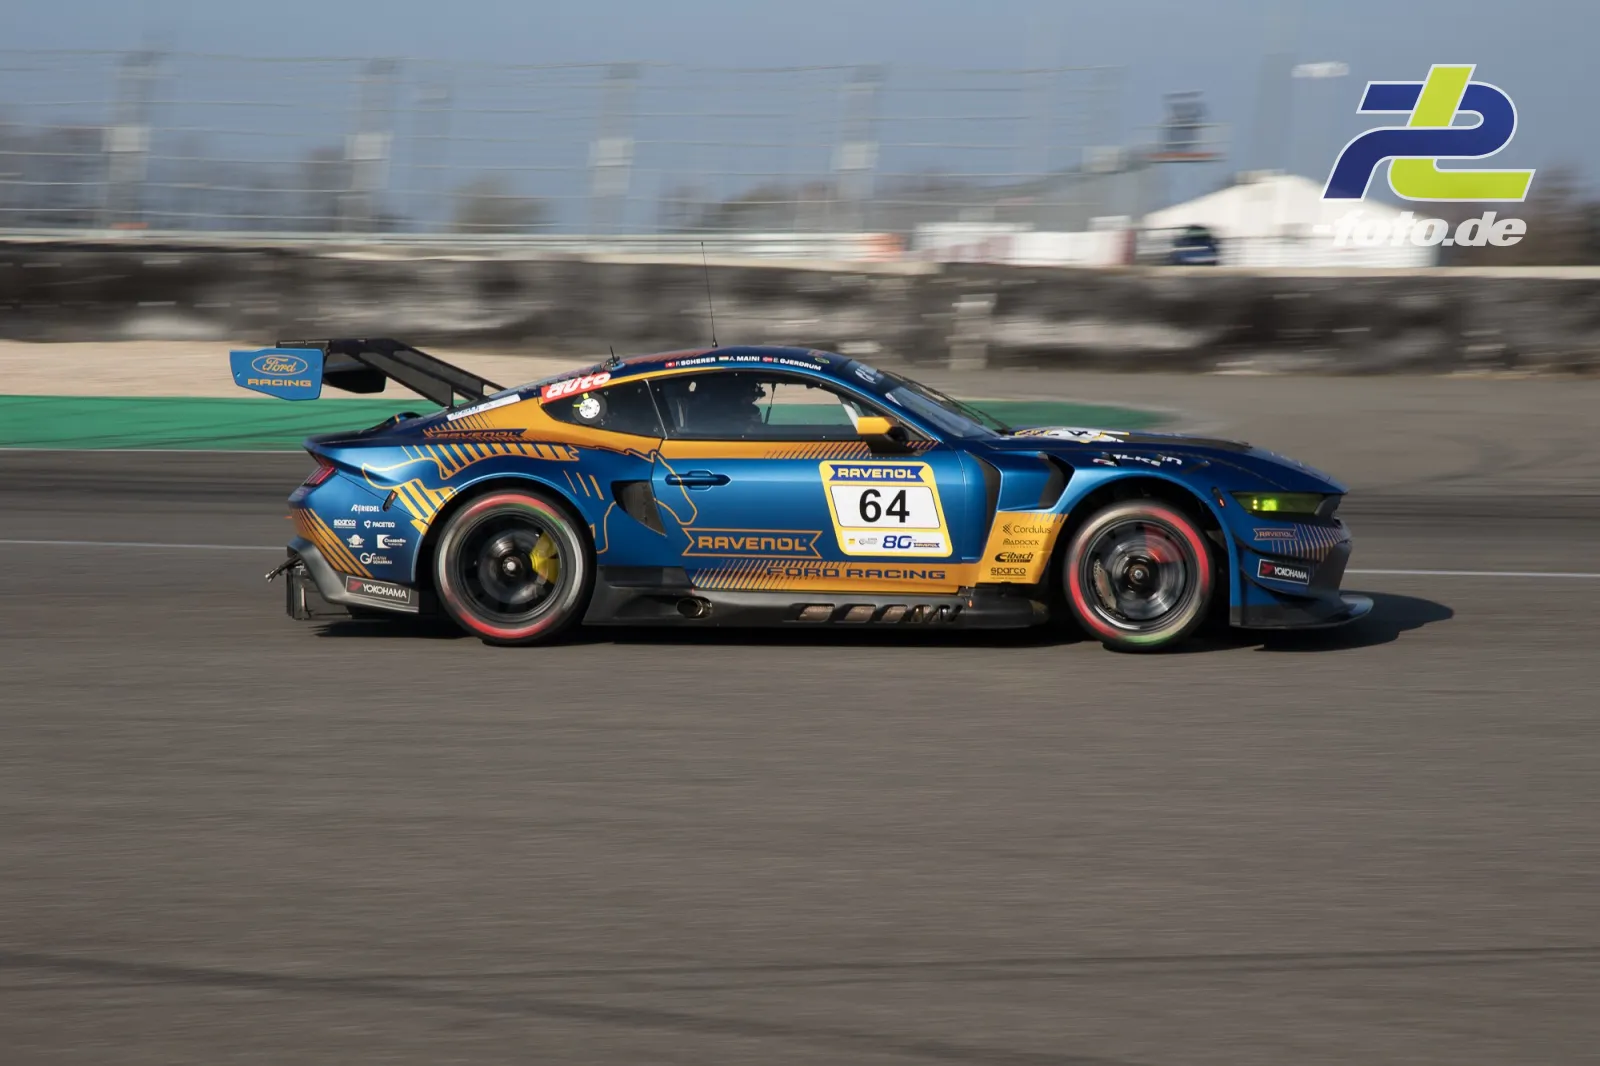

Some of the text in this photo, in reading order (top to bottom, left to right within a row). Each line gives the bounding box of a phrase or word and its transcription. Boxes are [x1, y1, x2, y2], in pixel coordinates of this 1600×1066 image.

[262, 357, 297, 373] Ford
[681, 357, 715, 366] SCHERER
[247, 378, 311, 388] RACING
[546, 373, 611, 398] auto
[837, 468, 916, 479] RAVENOL
[859, 489, 910, 523] 64
[1013, 525, 1052, 534] Cordulus
[698, 536, 807, 551] RAVENOL
[883, 535, 912, 549] 80
[995, 552, 1034, 562] Eibach
[766, 567, 946, 580] FORD RACING
[991, 567, 1026, 576] sparco
[1274, 566, 1308, 579] YOKOHAMA
[363, 584, 407, 598] YOKOHAMA
